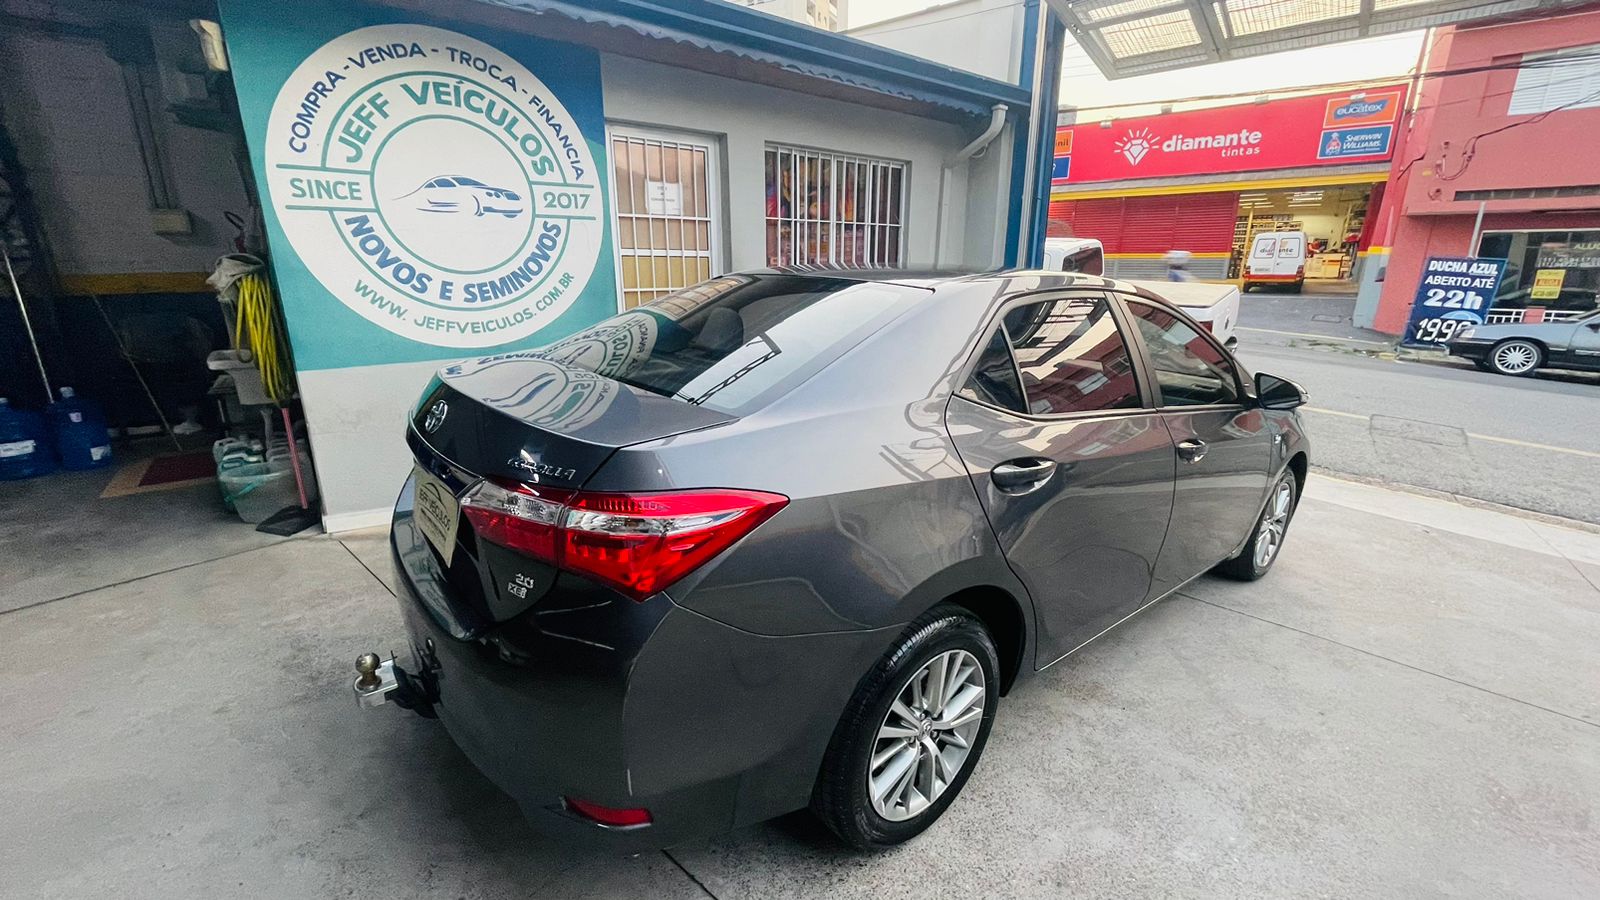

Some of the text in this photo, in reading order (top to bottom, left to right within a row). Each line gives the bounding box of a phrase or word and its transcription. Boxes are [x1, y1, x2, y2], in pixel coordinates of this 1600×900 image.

[288, 70, 346, 154] COMPRA
[347, 42, 427, 69] VENDA
[446, 46, 518, 92] TROCA
[528, 94, 585, 181] FINANCIA
[1336, 103, 1382, 116] eucatex
[338, 80, 555, 176] JEFF VEÍCULOS
[1162, 128, 1263, 153] diamante
[1221, 146, 1261, 158] tintas
[289, 177, 591, 210] SINCE 2017
[344, 214, 562, 303] NOVOS E SEMINOVOS
[1428, 260, 1499, 276] DUCHA AZUL
[1424, 275, 1496, 289] ABERTO ATÉ
[354, 279, 408, 321] WWW.
[1423, 288, 1484, 310] 22h
